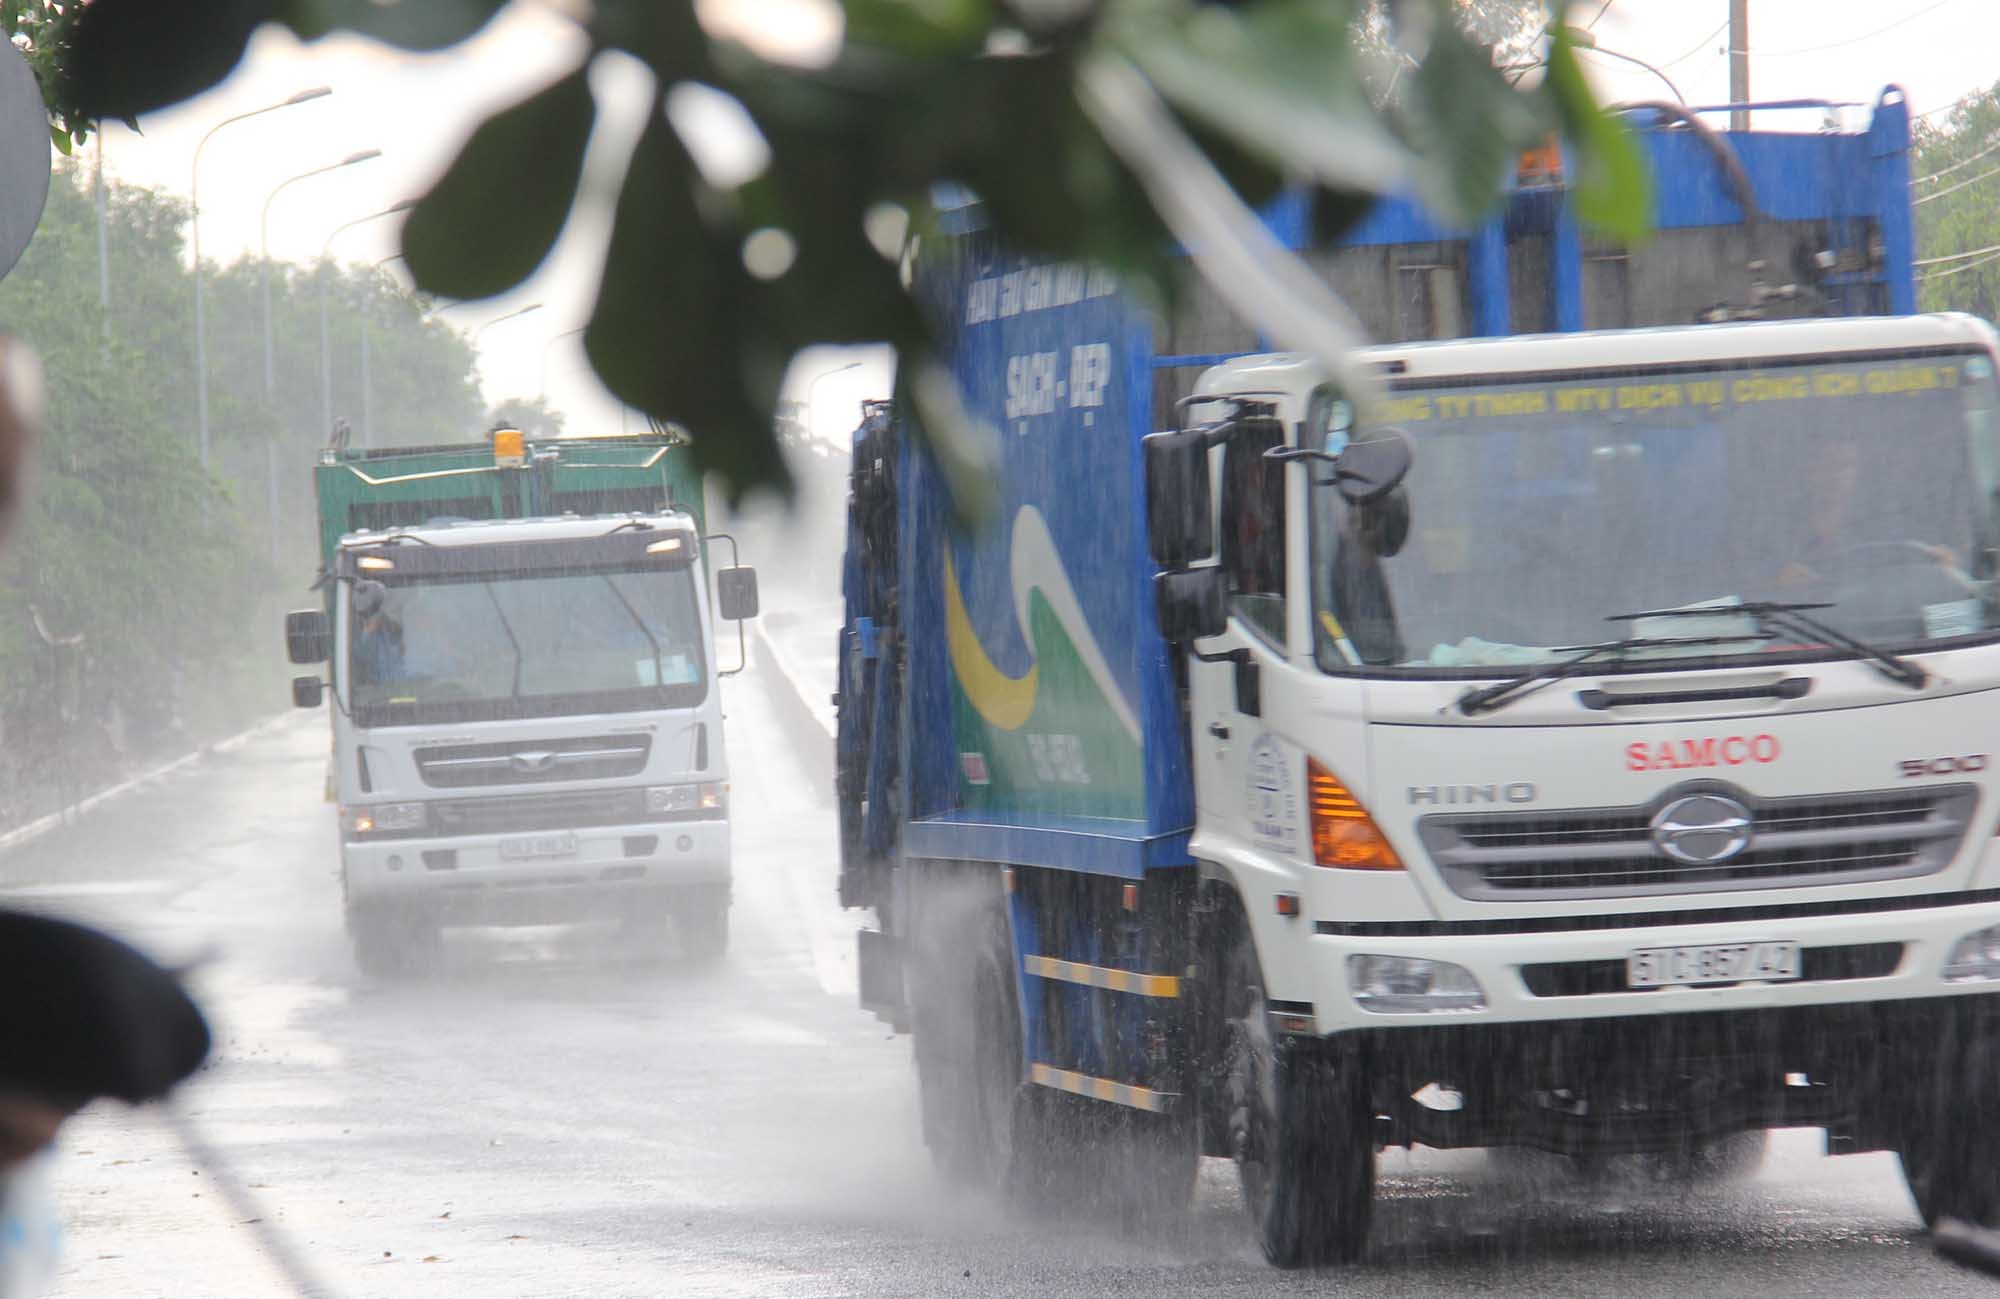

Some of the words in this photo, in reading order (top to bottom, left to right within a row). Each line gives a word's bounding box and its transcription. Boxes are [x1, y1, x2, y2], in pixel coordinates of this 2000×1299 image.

[1626, 734, 1782, 772] SAMCO
[1897, 753, 1989, 779] 500
[1407, 782, 1537, 805] HINO
